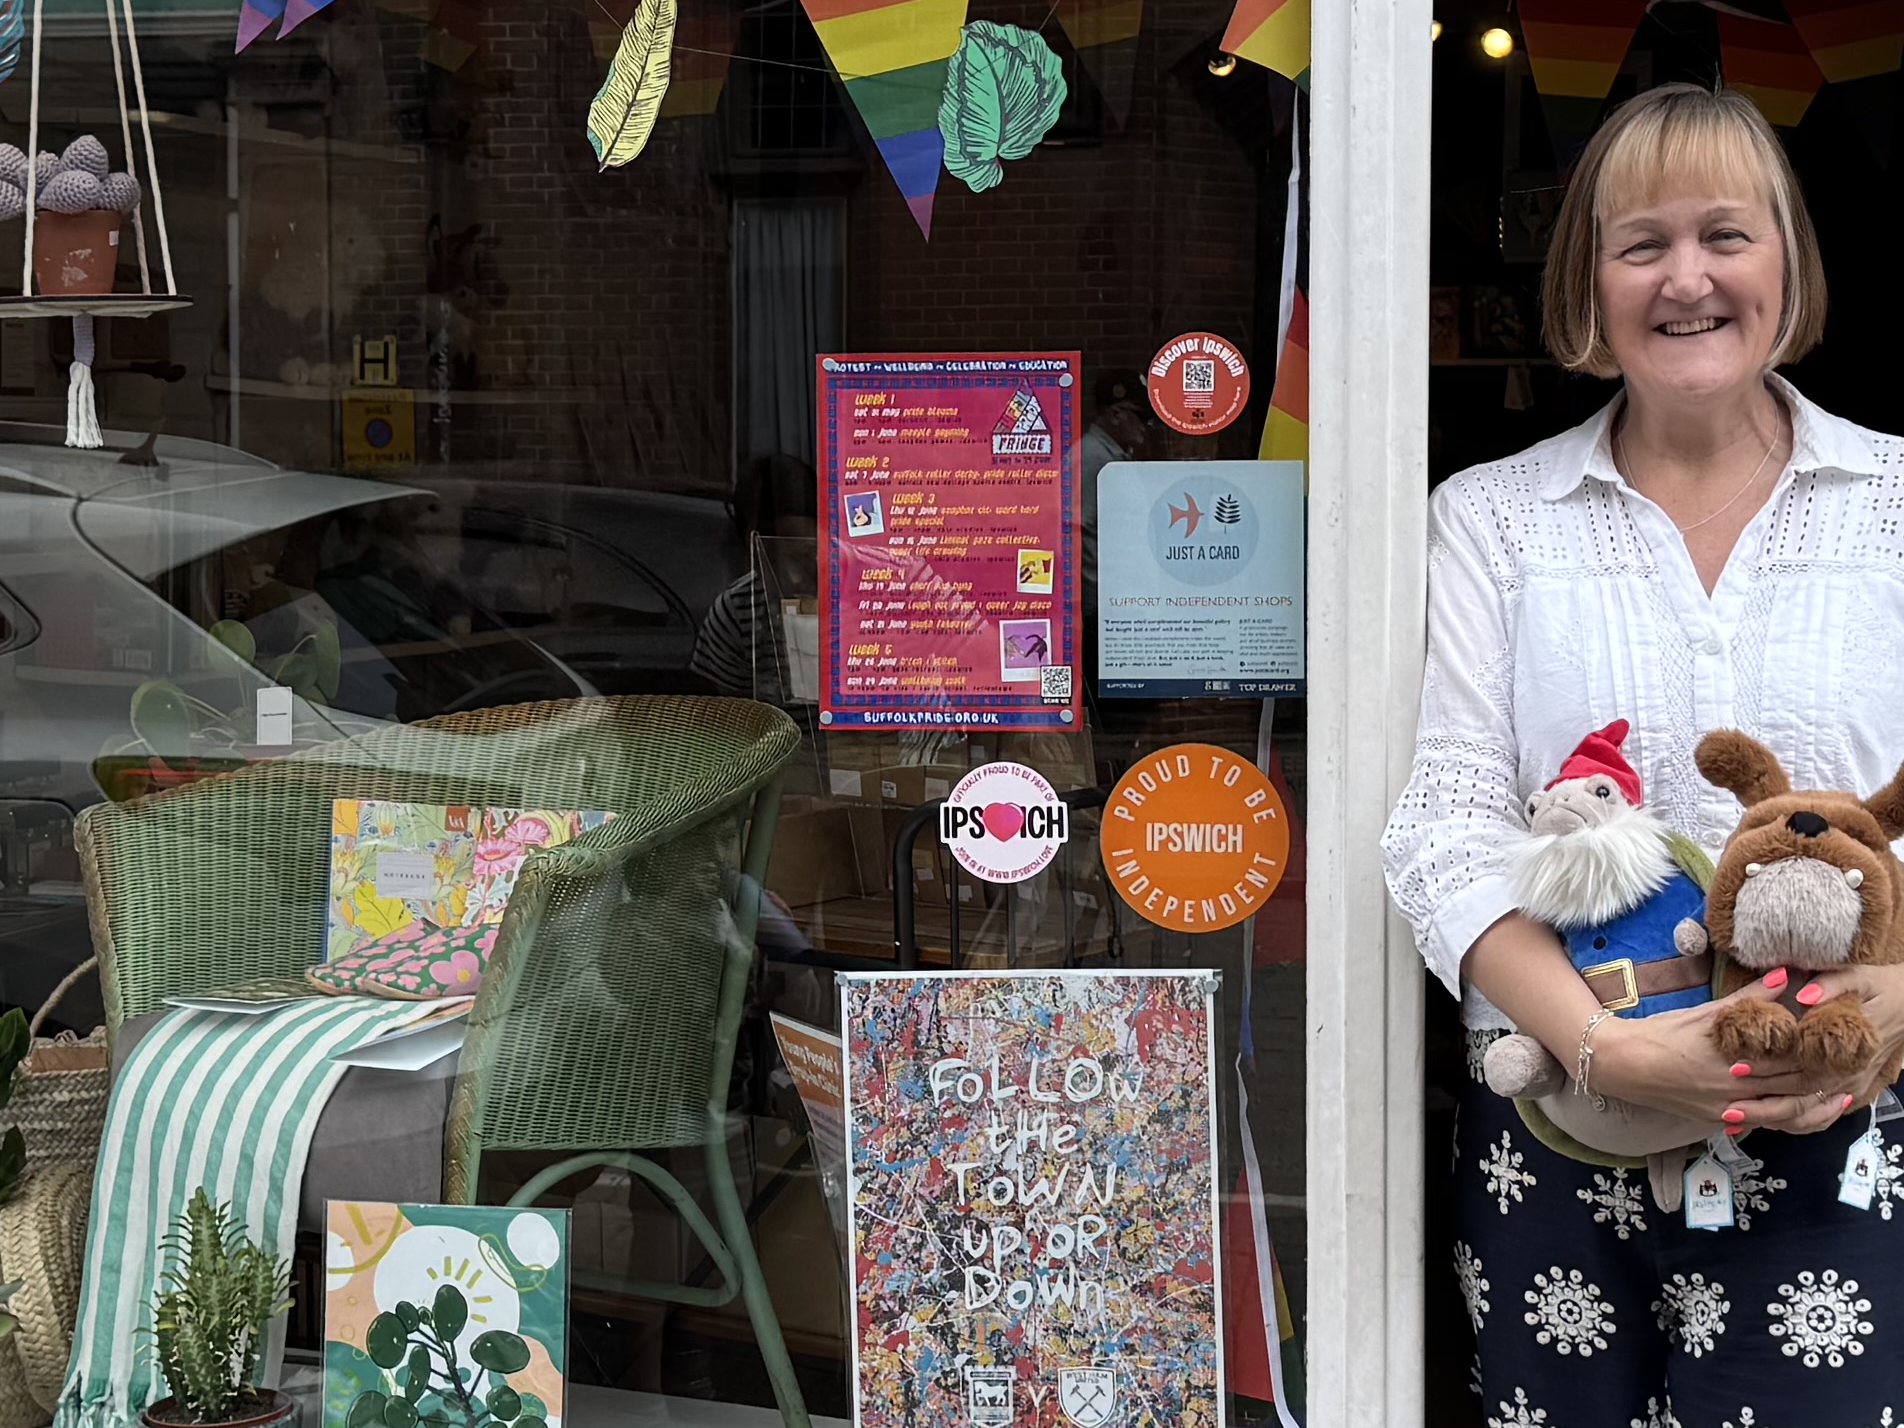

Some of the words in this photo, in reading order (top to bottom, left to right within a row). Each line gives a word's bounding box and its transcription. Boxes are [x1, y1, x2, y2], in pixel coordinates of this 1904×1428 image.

[1151, 338, 1200, 378] Discover
[1202, 336, 1245, 378] Ipswich
[1166, 546, 1195, 560] JUST
[1197, 546, 1206, 560] A
[1209, 545, 1240, 560] CARD
[1109, 596, 1161, 607] SUPPORT
[1165, 596, 1251, 607] INDEPENDENT
[1254, 596, 1293, 606] SHOPS
[1113, 754, 1191, 822] PROUD
[1209, 756, 1242, 788] TO
[1243, 788, 1277, 824] BE
[1146, 823, 1243, 853] IPSWICH
[1112, 848, 1276, 923] INDEPENDENT
